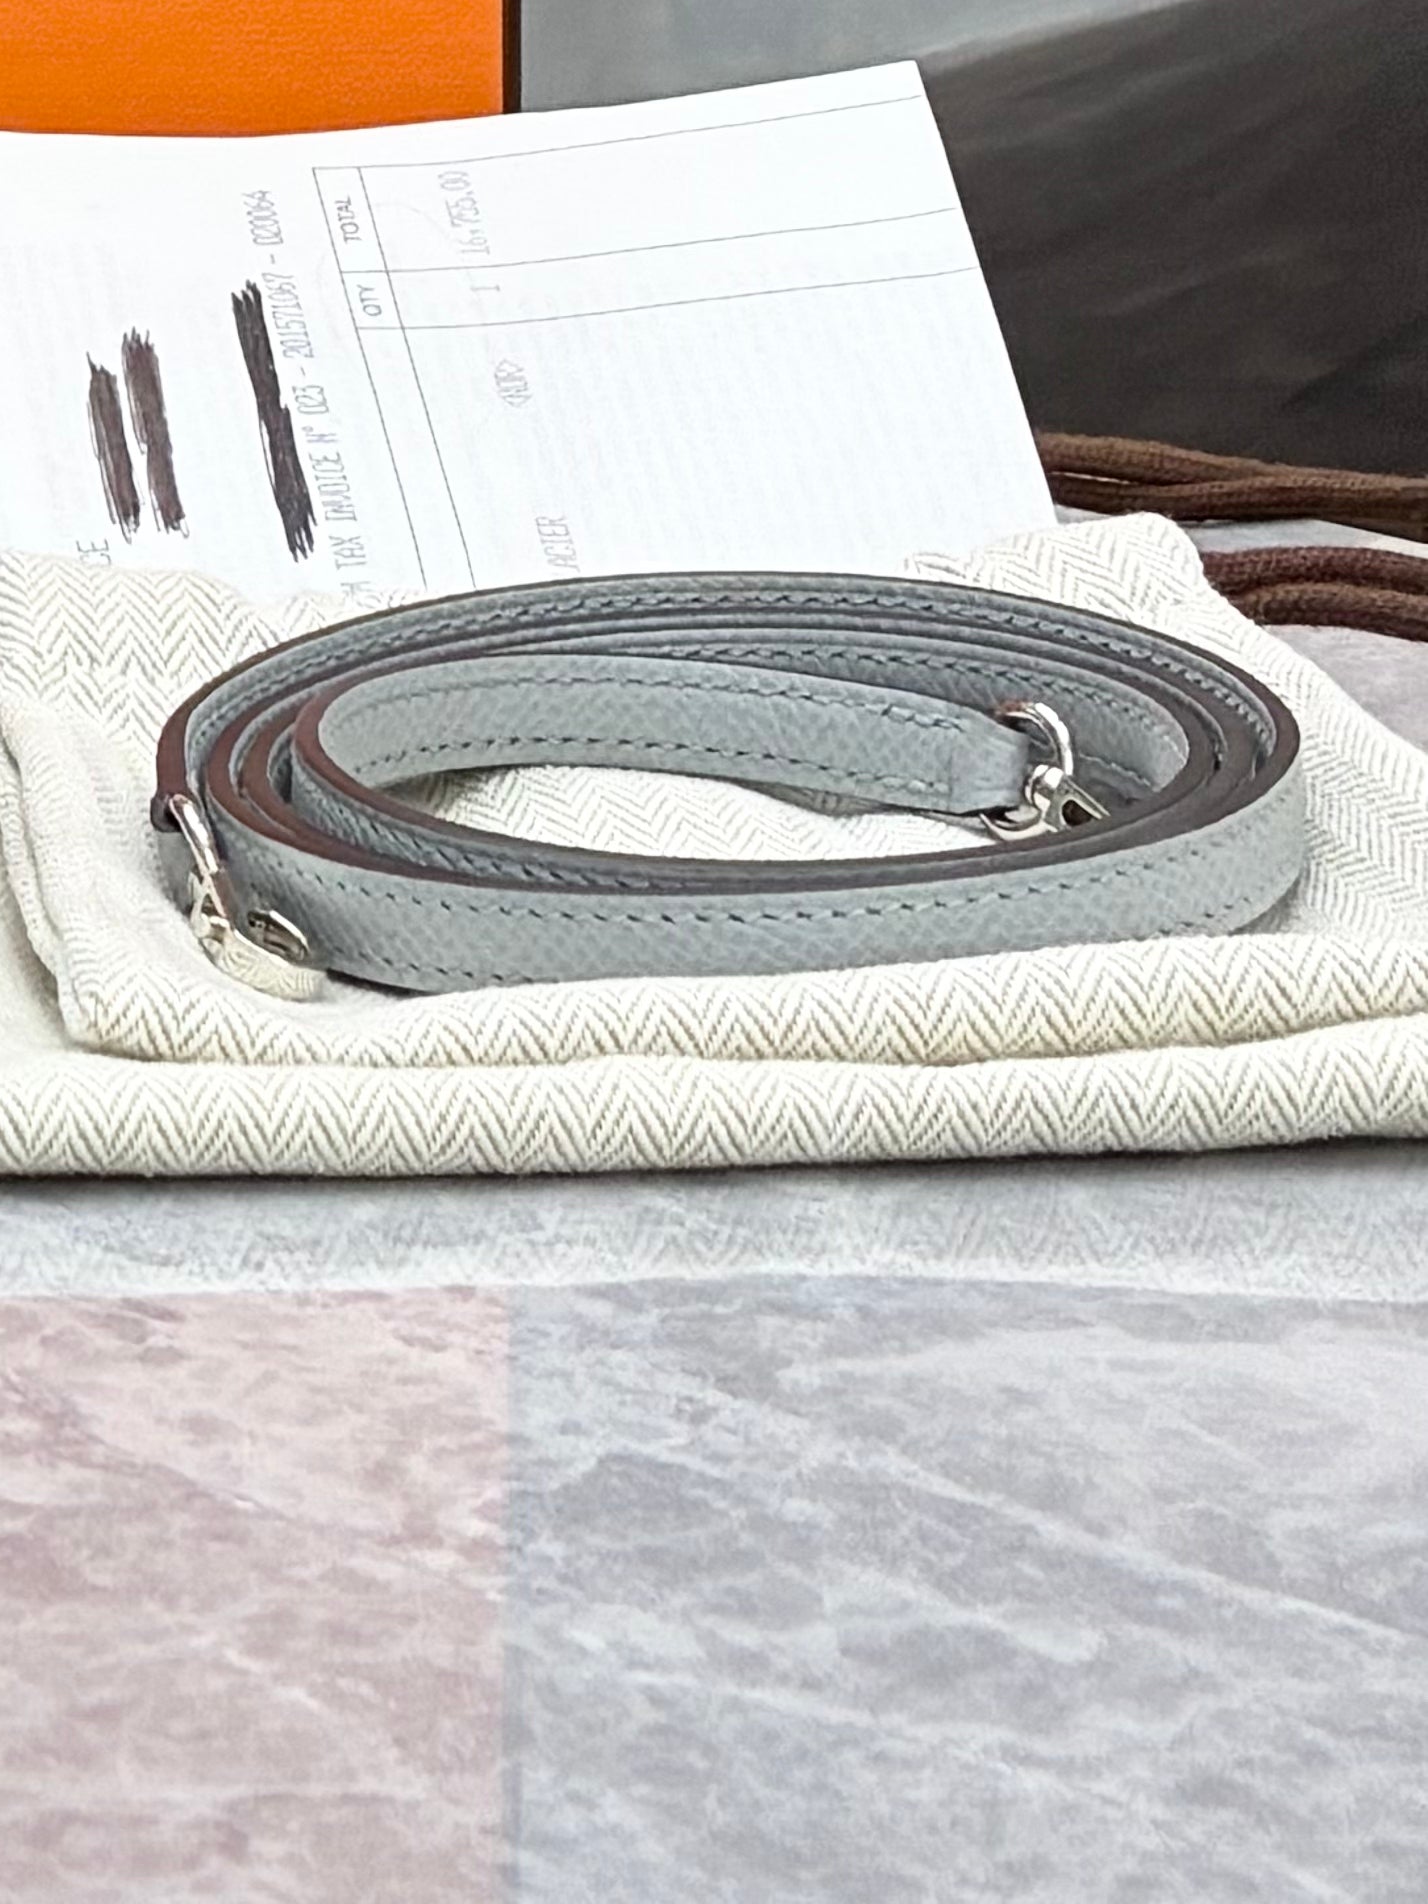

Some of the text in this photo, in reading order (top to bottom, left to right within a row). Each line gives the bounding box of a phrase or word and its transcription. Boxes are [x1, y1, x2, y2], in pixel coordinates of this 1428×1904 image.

[334, 195, 363, 245] TOTAL
[356, 283, 383, 317] QTY
[308, 450, 358, 522] INVOICE
[328, 535, 368, 570] TAX
